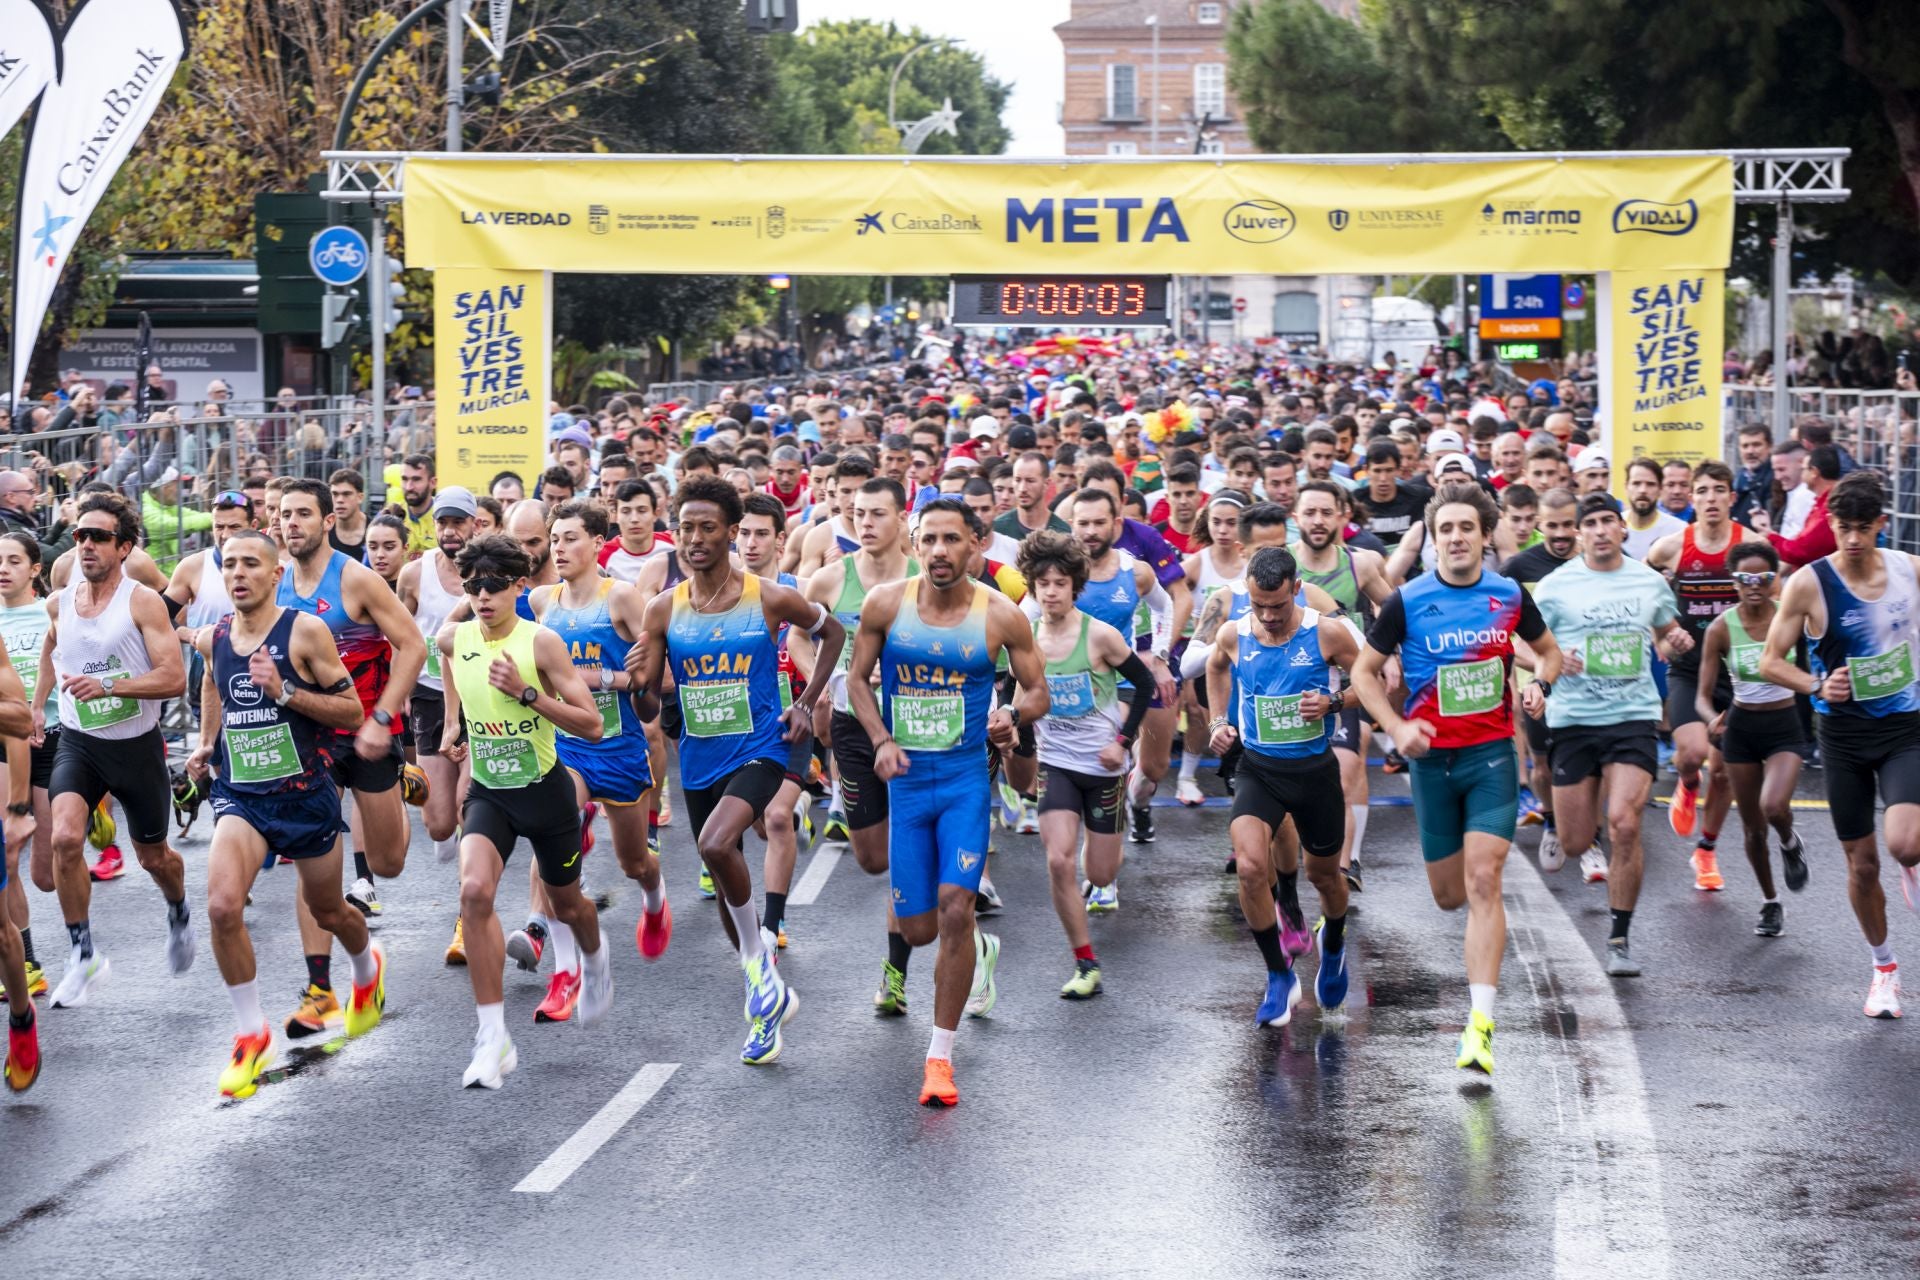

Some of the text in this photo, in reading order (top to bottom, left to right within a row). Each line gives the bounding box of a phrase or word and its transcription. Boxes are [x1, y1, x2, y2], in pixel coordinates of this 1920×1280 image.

[57, 47, 165, 196] CaixaBank
[461, 211, 572, 226] LA VERDAD
[892, 212, 983, 231] CaixaBank
[1006, 196, 1190, 243] META
[1231, 213, 1288, 231] Juver
[1358, 209, 1445, 222] UNIVERSAE
[1503, 210, 1581, 225] marmo
[1625, 209, 1688, 226] VIDAL
[453, 284, 526, 319] SAN
[1001, 283, 1146, 315] 0:00:03
[1513, 295, 1544, 309] 24h
[1630, 278, 1704, 314] SAN
[464, 313, 515, 344] SIL
[1641, 307, 1693, 340] SIL
[168, 342, 236, 353] AVANZADA
[457, 336, 523, 370] VES
[1501, 344, 1538, 359] LIBRE
[1634, 331, 1700, 367] VES
[91, 357, 99, 367] Y
[161, 357, 210, 367] DENTAL
[458, 363, 525, 397] TRE
[1635, 359, 1702, 394] TRE
[457, 388, 530, 415] MURCIA
[1634, 385, 1707, 412] MURCIA
[458, 425, 528, 434] LA VERDAD
[1633, 421, 1704, 432] LA VERDAD
[83, 662, 110, 674] Aloha
[683, 652, 753, 678] UCAM
[234, 689, 259, 699] Reina
[686, 690, 706, 701] SAN
[686, 687, 742, 709] SILVESTRE
[1454, 682, 1496, 702] 3152
[87, 696, 124, 715] 1126
[694, 706, 737, 723] 3182
[1261, 699, 1283, 711] SAN
[226, 707, 279, 726] PROTEINAS
[1269, 715, 1312, 731] 358
[905, 719, 949, 736] 1326
[231, 732, 249, 745] SAN
[233, 727, 285, 753] SILVESTRE
[475, 740, 493, 751] SAN
[240, 749, 283, 768] 1755
[476, 740, 528, 760] SILVESTRE
[486, 758, 523, 774] 092
